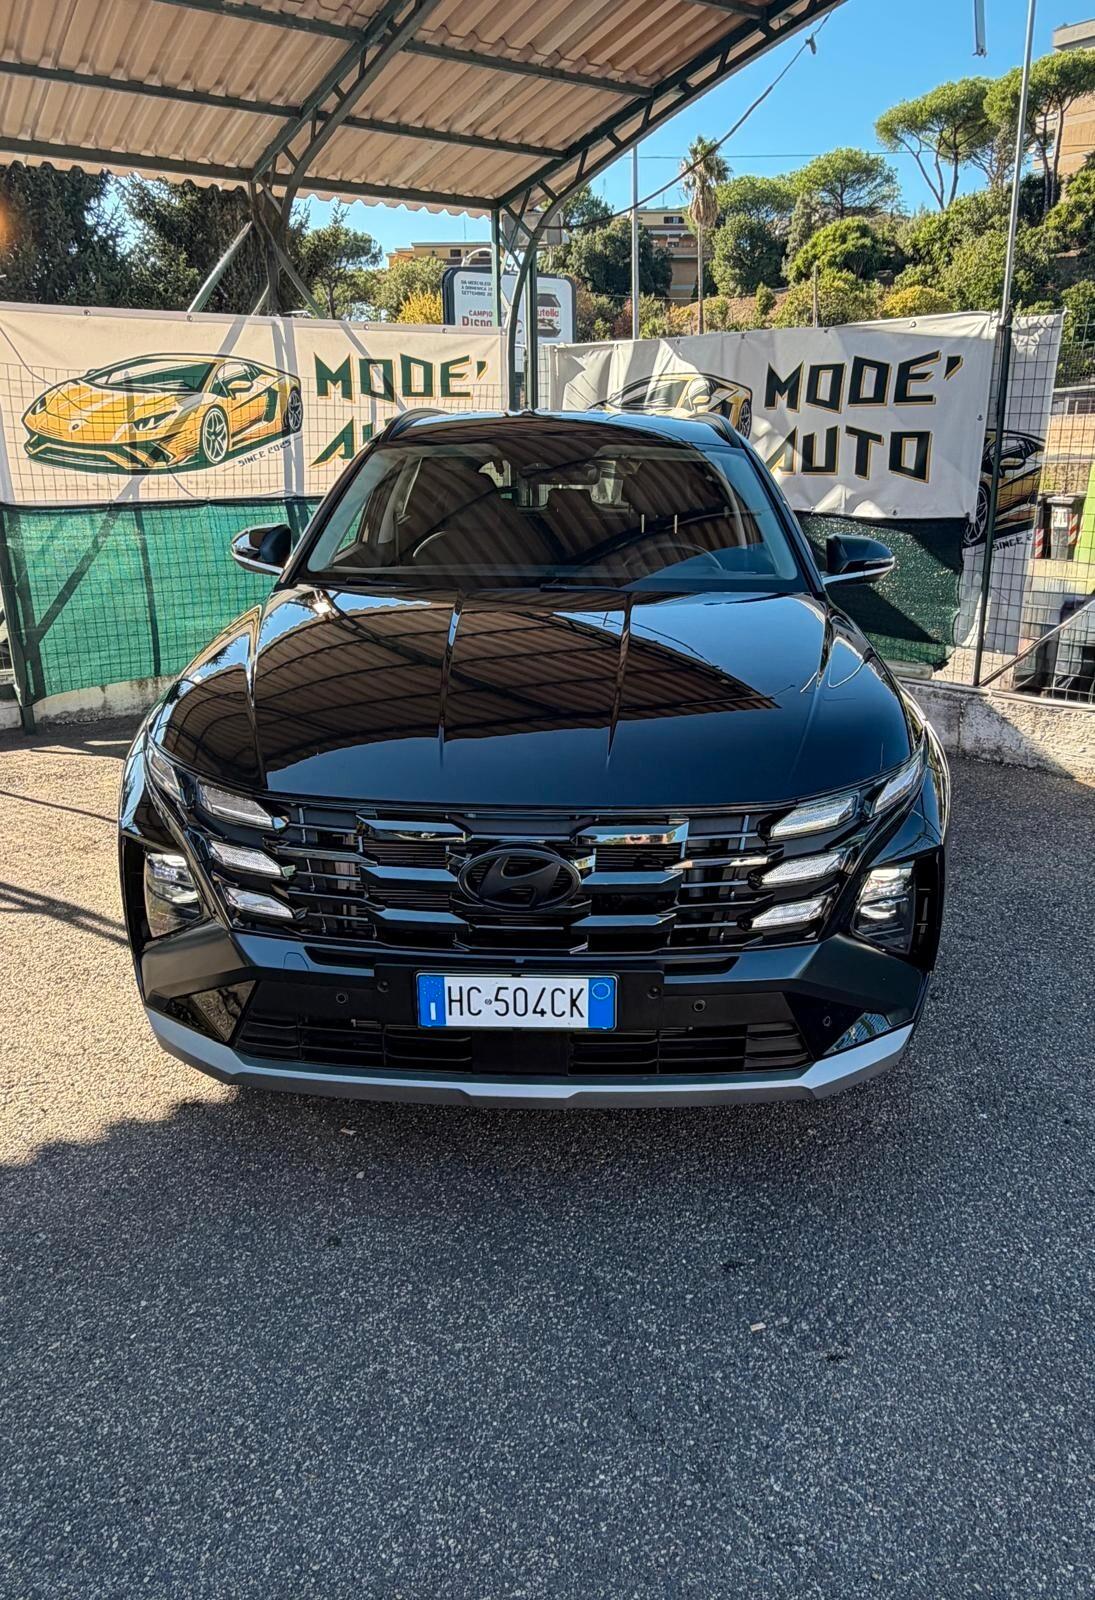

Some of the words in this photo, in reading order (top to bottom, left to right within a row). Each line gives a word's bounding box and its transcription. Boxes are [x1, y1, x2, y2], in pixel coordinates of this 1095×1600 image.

[313, 351, 488, 404] MODE'
[764, 350, 963, 414] MODE'
[237, 450, 266, 467] SINCE
[766, 425, 934, 482] AUTO
[992, 536, 1024, 551] SINCE
